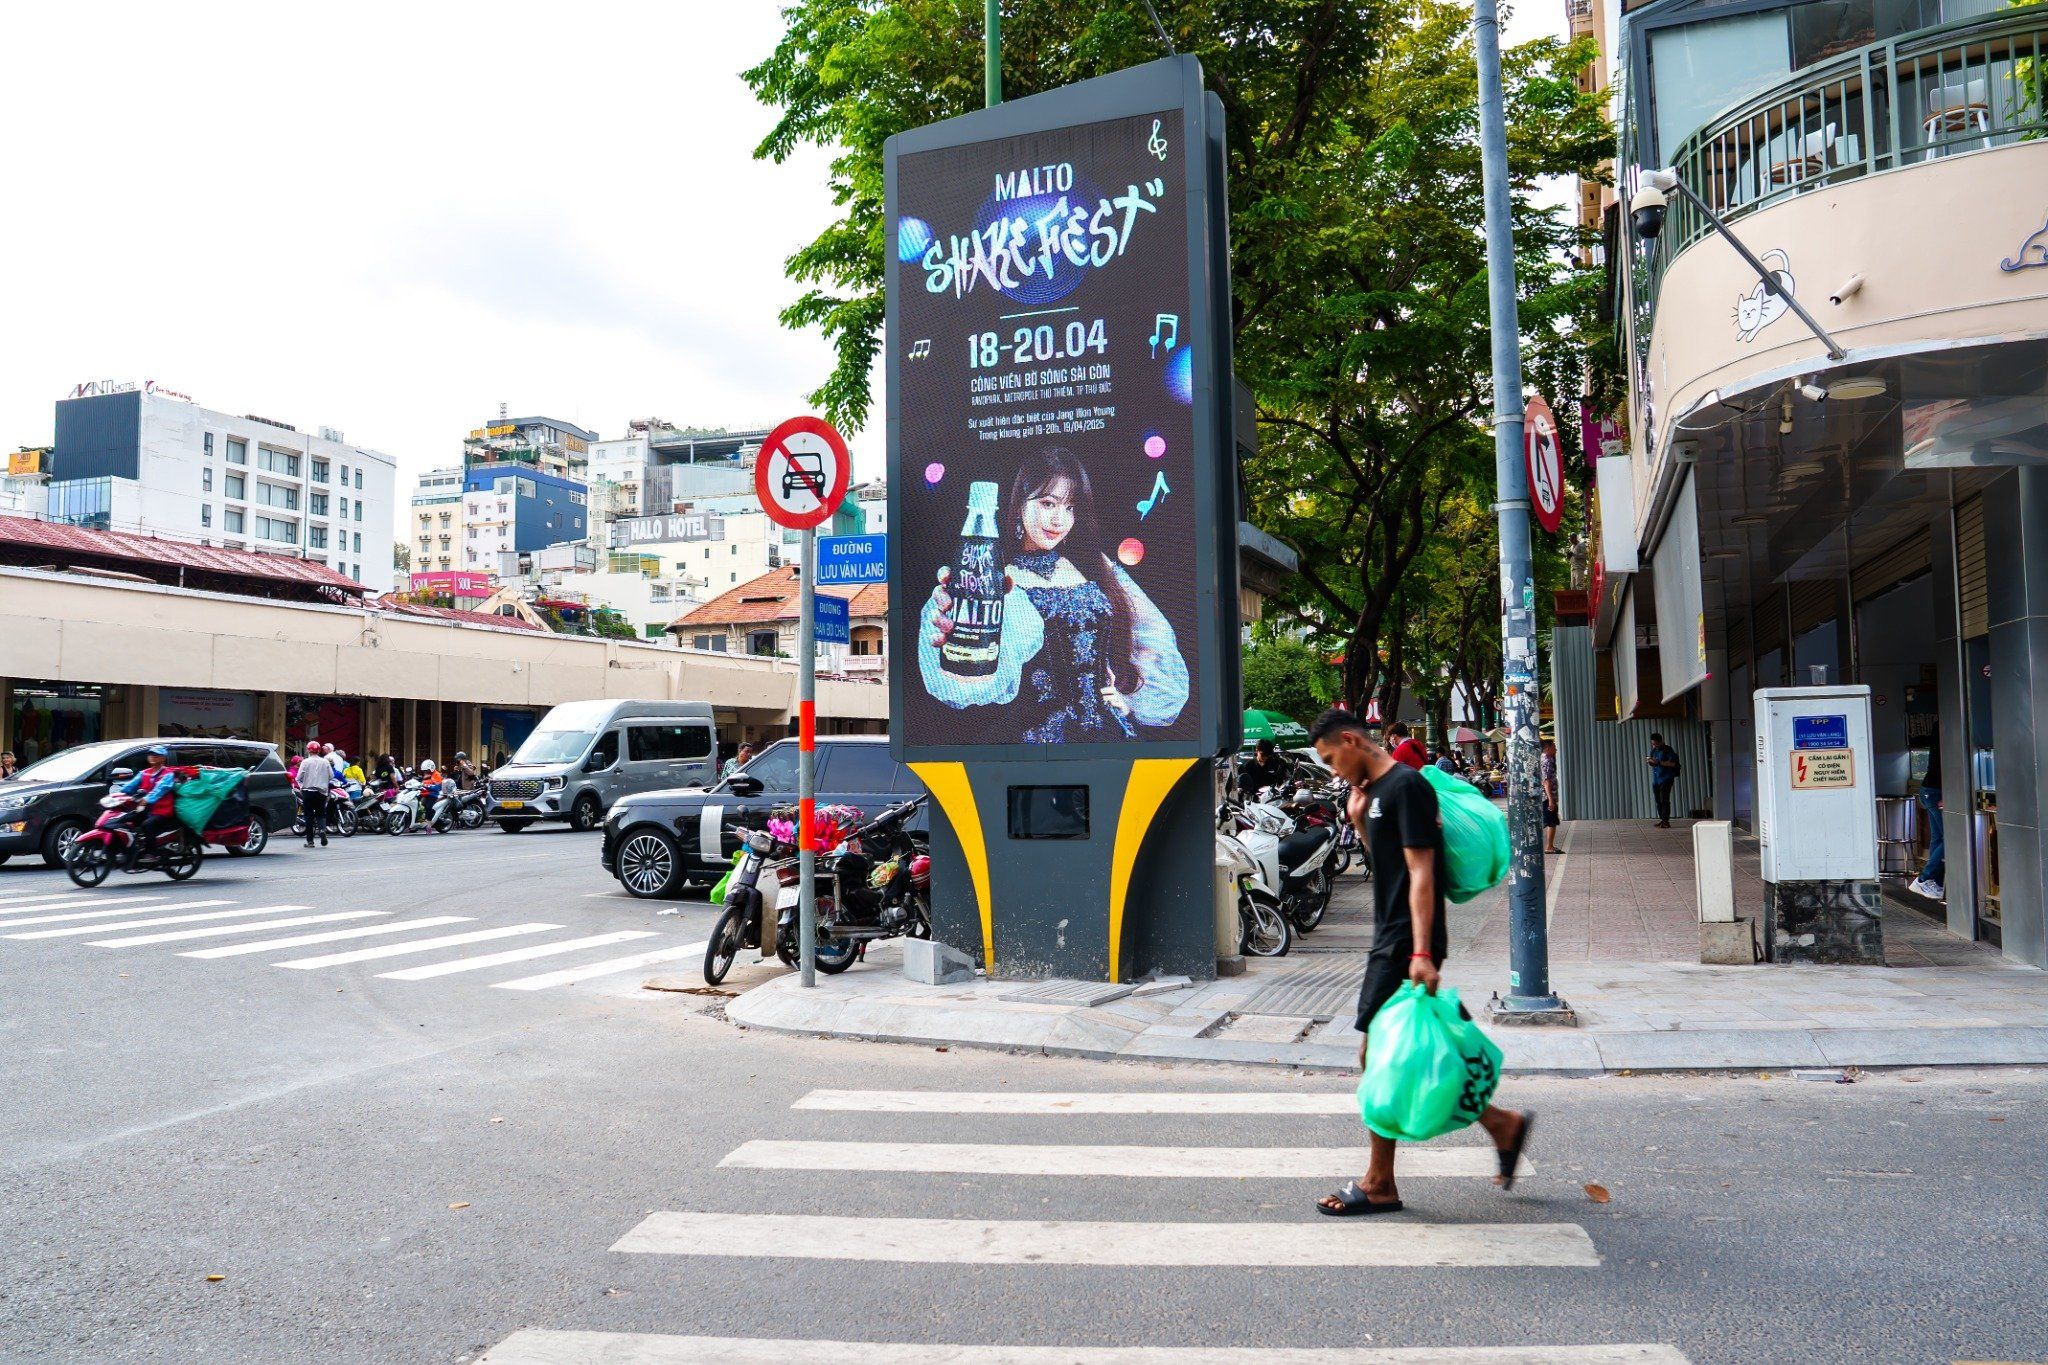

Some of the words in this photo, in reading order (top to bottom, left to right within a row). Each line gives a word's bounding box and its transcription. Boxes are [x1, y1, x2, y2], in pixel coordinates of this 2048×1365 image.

[995, 162, 1074, 201] MALTO
[968, 318, 1108, 369] 18-20.04
[970, 376, 998, 392] CÔNG
[1000, 372, 1021, 389] VIÊN
[1040, 368, 1068, 385] SÔNG
[1070, 365, 1086, 382] SÀI
[1089, 363, 1110, 380] GÒN
[630, 519, 662, 541] HALO
[668, 516, 707, 538] HOTEL
[832, 540, 872, 555] ĐƯỜNG
[821, 563, 838, 579] LƯU
[840, 560, 857, 578] VĂN
[859, 562, 884, 578] LANG
